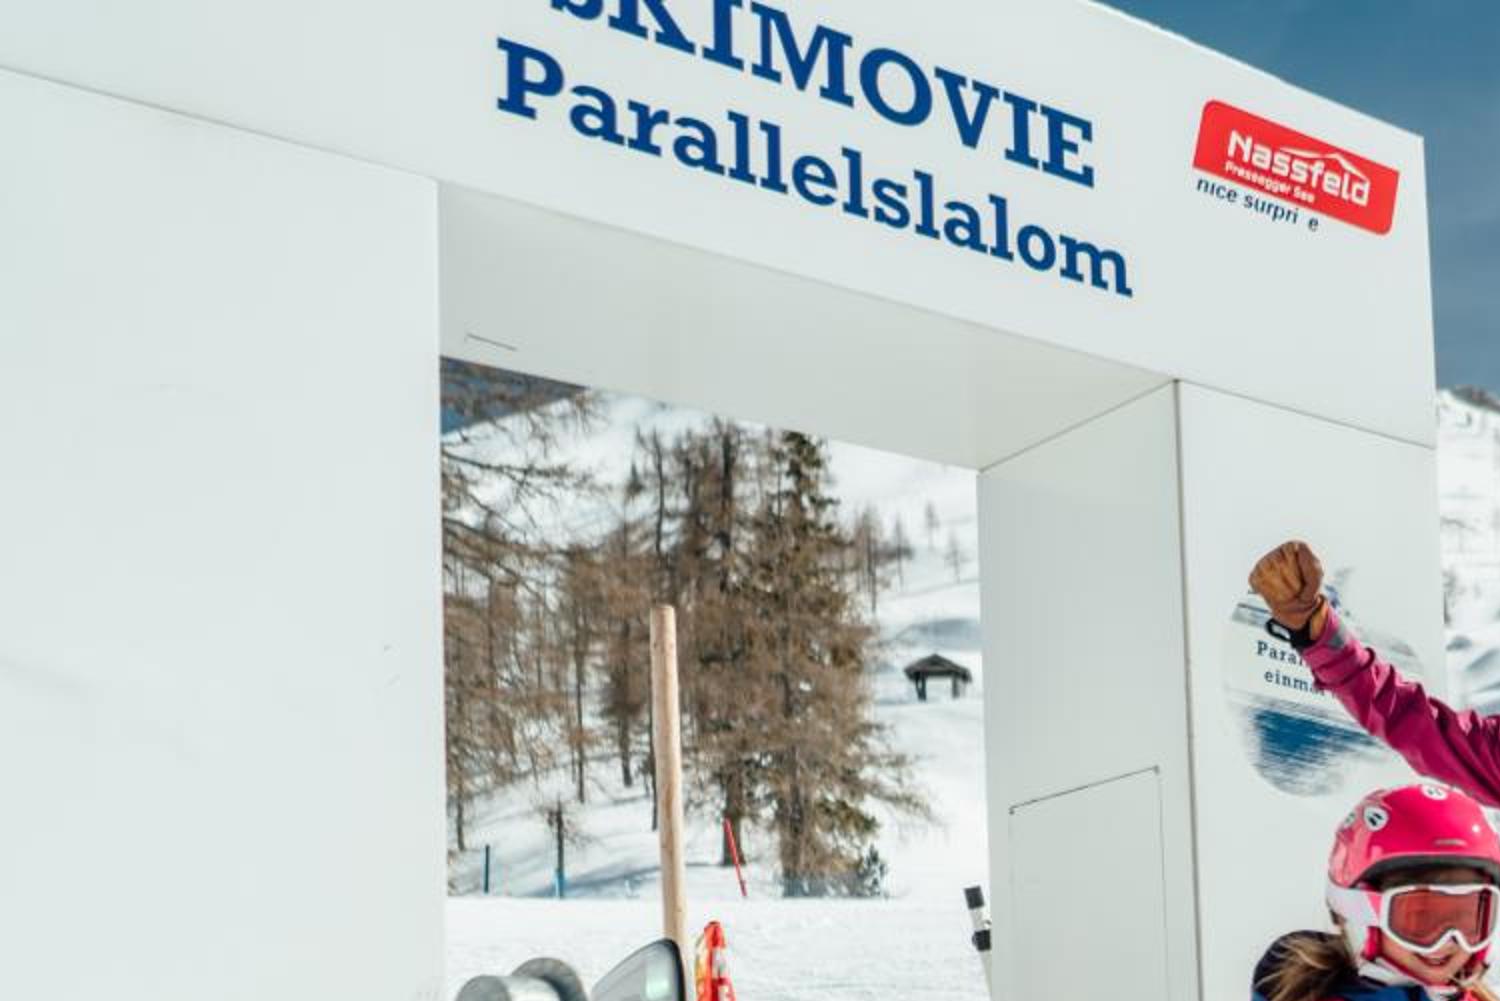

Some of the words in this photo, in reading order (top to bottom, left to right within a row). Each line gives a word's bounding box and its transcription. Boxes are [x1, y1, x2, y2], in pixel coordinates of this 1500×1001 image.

[551, 0, 1094, 188] KIMOVIE
[497, 39, 1133, 298] Parallelslalom
[1196, 177, 1239, 203] nice
[1243, 193, 1320, 232] surprie
[1226, 129, 1370, 207] Nassfeld
[1264, 669, 1324, 696] einm
